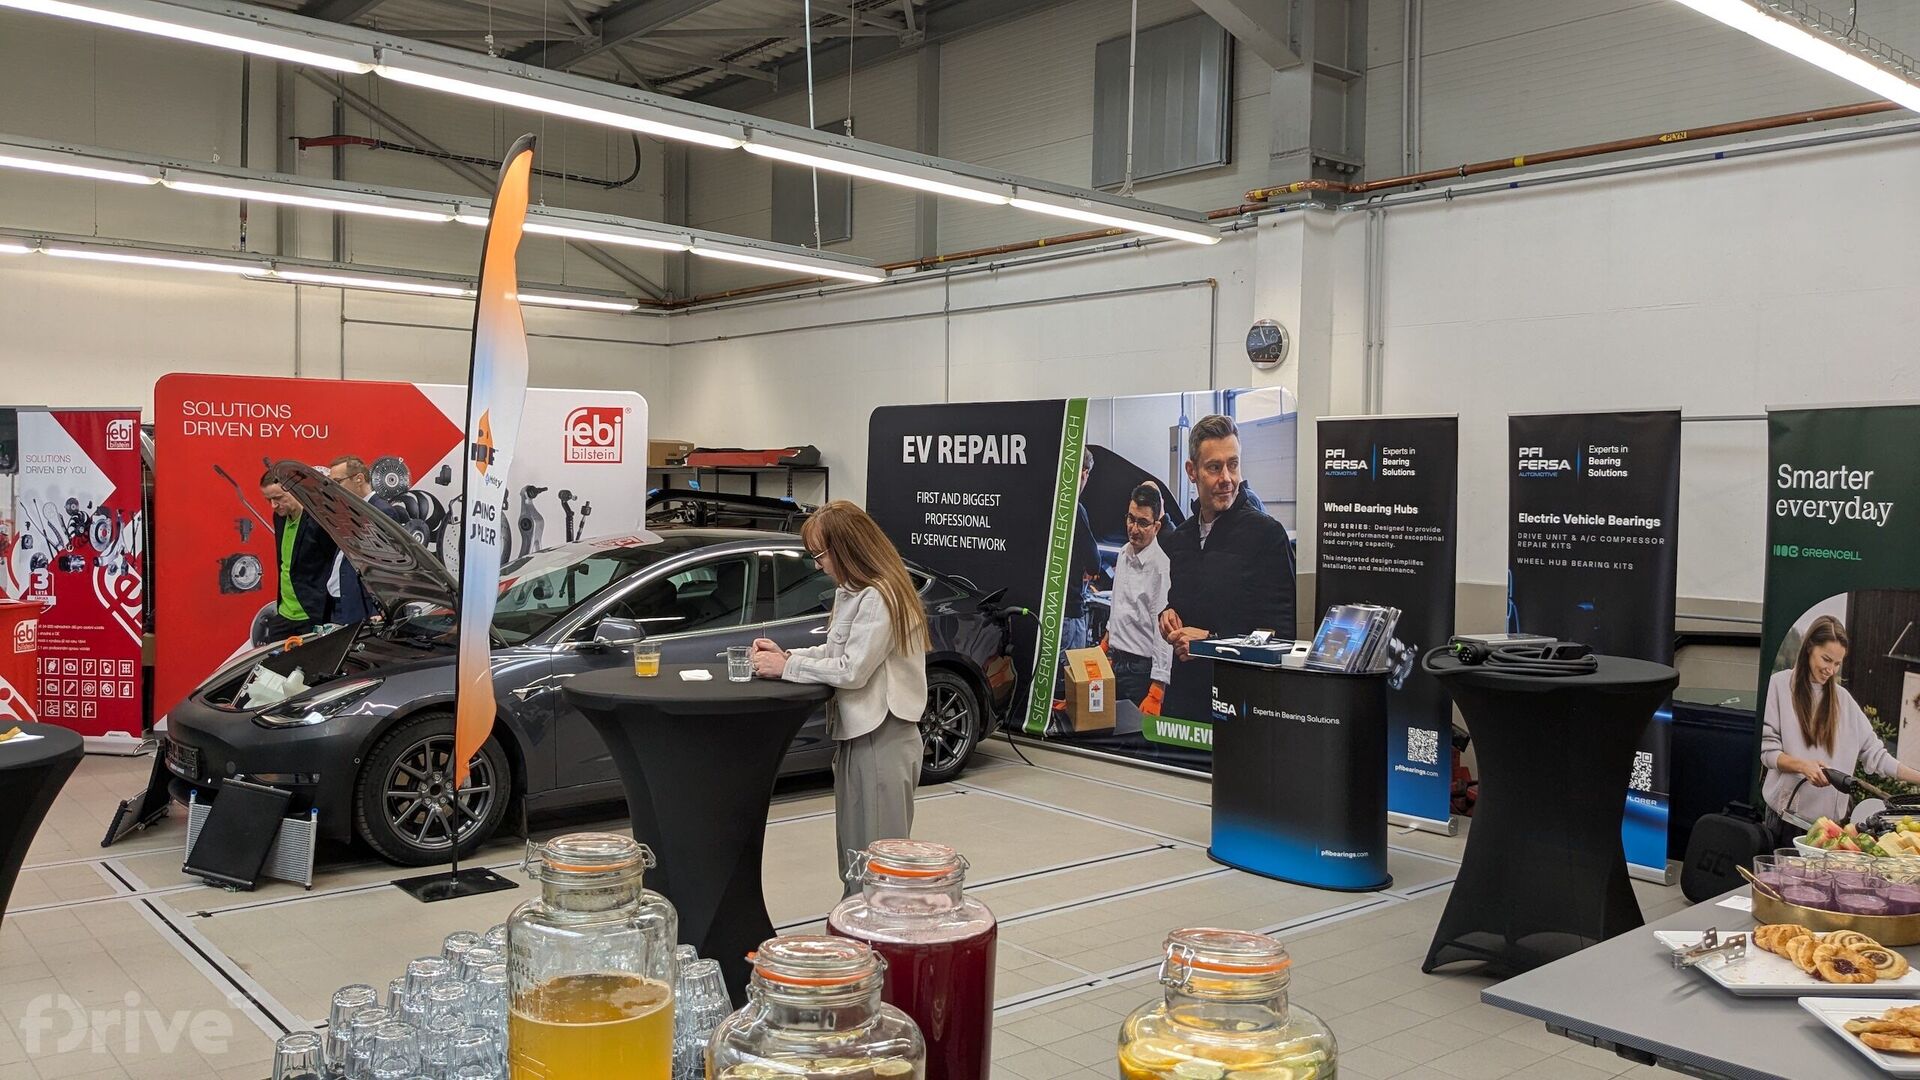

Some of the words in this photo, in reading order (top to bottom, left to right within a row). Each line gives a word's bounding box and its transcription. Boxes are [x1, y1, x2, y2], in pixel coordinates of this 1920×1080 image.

[182, 400, 292, 419] SOLUTIONS
[106, 421, 133, 441] febi
[183, 421, 253, 437] DRIVEN
[260, 423, 284, 438] BY
[290, 424, 329, 439] YOU
[564, 409, 622, 447] febi
[572, 448, 615, 460] bilstein
[902, 435, 933, 464] EV
[937, 434, 1027, 465] REPAIR
[1325, 448, 1345, 459] PFI
[1382, 447, 1409, 457] Experts
[1409, 447, 1416, 455] in
[1518, 447, 1543, 458] PFI
[1588, 445, 1619, 455] Experts
[1620, 445, 1628, 453] in
[25, 455, 71, 463] SOLUTIONS
[1325, 459, 1368, 470] FERSA
[1382, 457, 1410, 467] Bearing
[1518, 459, 1571, 470] FERSA
[1588, 457, 1621, 467] Bearing
[25, 466, 55, 474] DRIVEN
[57, 466, 67, 474] BY
[1382, 468, 1416, 477] Solutions
[1588, 469, 1628, 477] Solutions
[1777, 463, 1874, 490] Smarter
[1054, 415, 1080, 550] ELEKTRYCZNYCH
[916, 491, 940, 504] FIRST
[941, 492, 961, 505] AND
[963, 493, 1001, 507] BIGGEST
[1324, 502, 1352, 513] Wheel
[1354, 503, 1392, 516] Bearing
[1394, 504, 1418, 515] Hubs
[1775, 496, 1894, 527] everyday
[924, 512, 991, 529] PROFESSIONAL
[1518, 512, 1561, 524] Electric
[1563, 513, 1605, 526] Vehicle
[1608, 515, 1661, 529] Bearings
[1374, 524, 1405, 532] Designed
[1415, 526, 1441, 534] provide
[911, 533, 922, 545] EV
[923, 533, 958, 548] SERVICE
[959, 536, 1007, 552] NETWORK
[1346, 532, 1389, 541] performance
[1404, 534, 1445, 543] exceptional
[1517, 532, 1542, 540] DRIVE
[1571, 534, 1577, 542] &
[1580, 535, 1596, 543] A/C
[1600, 535, 1665, 545] COMPRESSOR
[1336, 540, 1363, 548] carrying
[1364, 541, 1396, 549] capacity.
[1517, 540, 1547, 549] REPAIR
[1551, 542, 1572, 550] KITS
[1322, 562, 1356, 570] installation
[1335, 555, 1369, 564] integrated
[1370, 557, 1393, 565] design
[1393, 558, 1424, 567] simplifies
[1517, 557, 1545, 565] WHEEL
[1549, 558, 1567, 566] HUB
[1571, 560, 1610, 569] BEARING
[1613, 562, 1634, 570] KITS
[1050, 554, 1065, 587] AUT
[33, 567, 49, 590] 3
[14, 622, 37, 644] febi
[1037, 591, 1059, 687] SERWISOWA
[1212, 700, 1237, 716] ERSA
[1252, 706, 1275, 718] Experts
[1275, 708, 1281, 717] in
[1281, 711, 1306, 723] Bearing
[1306, 714, 1340, 725] Solutions
